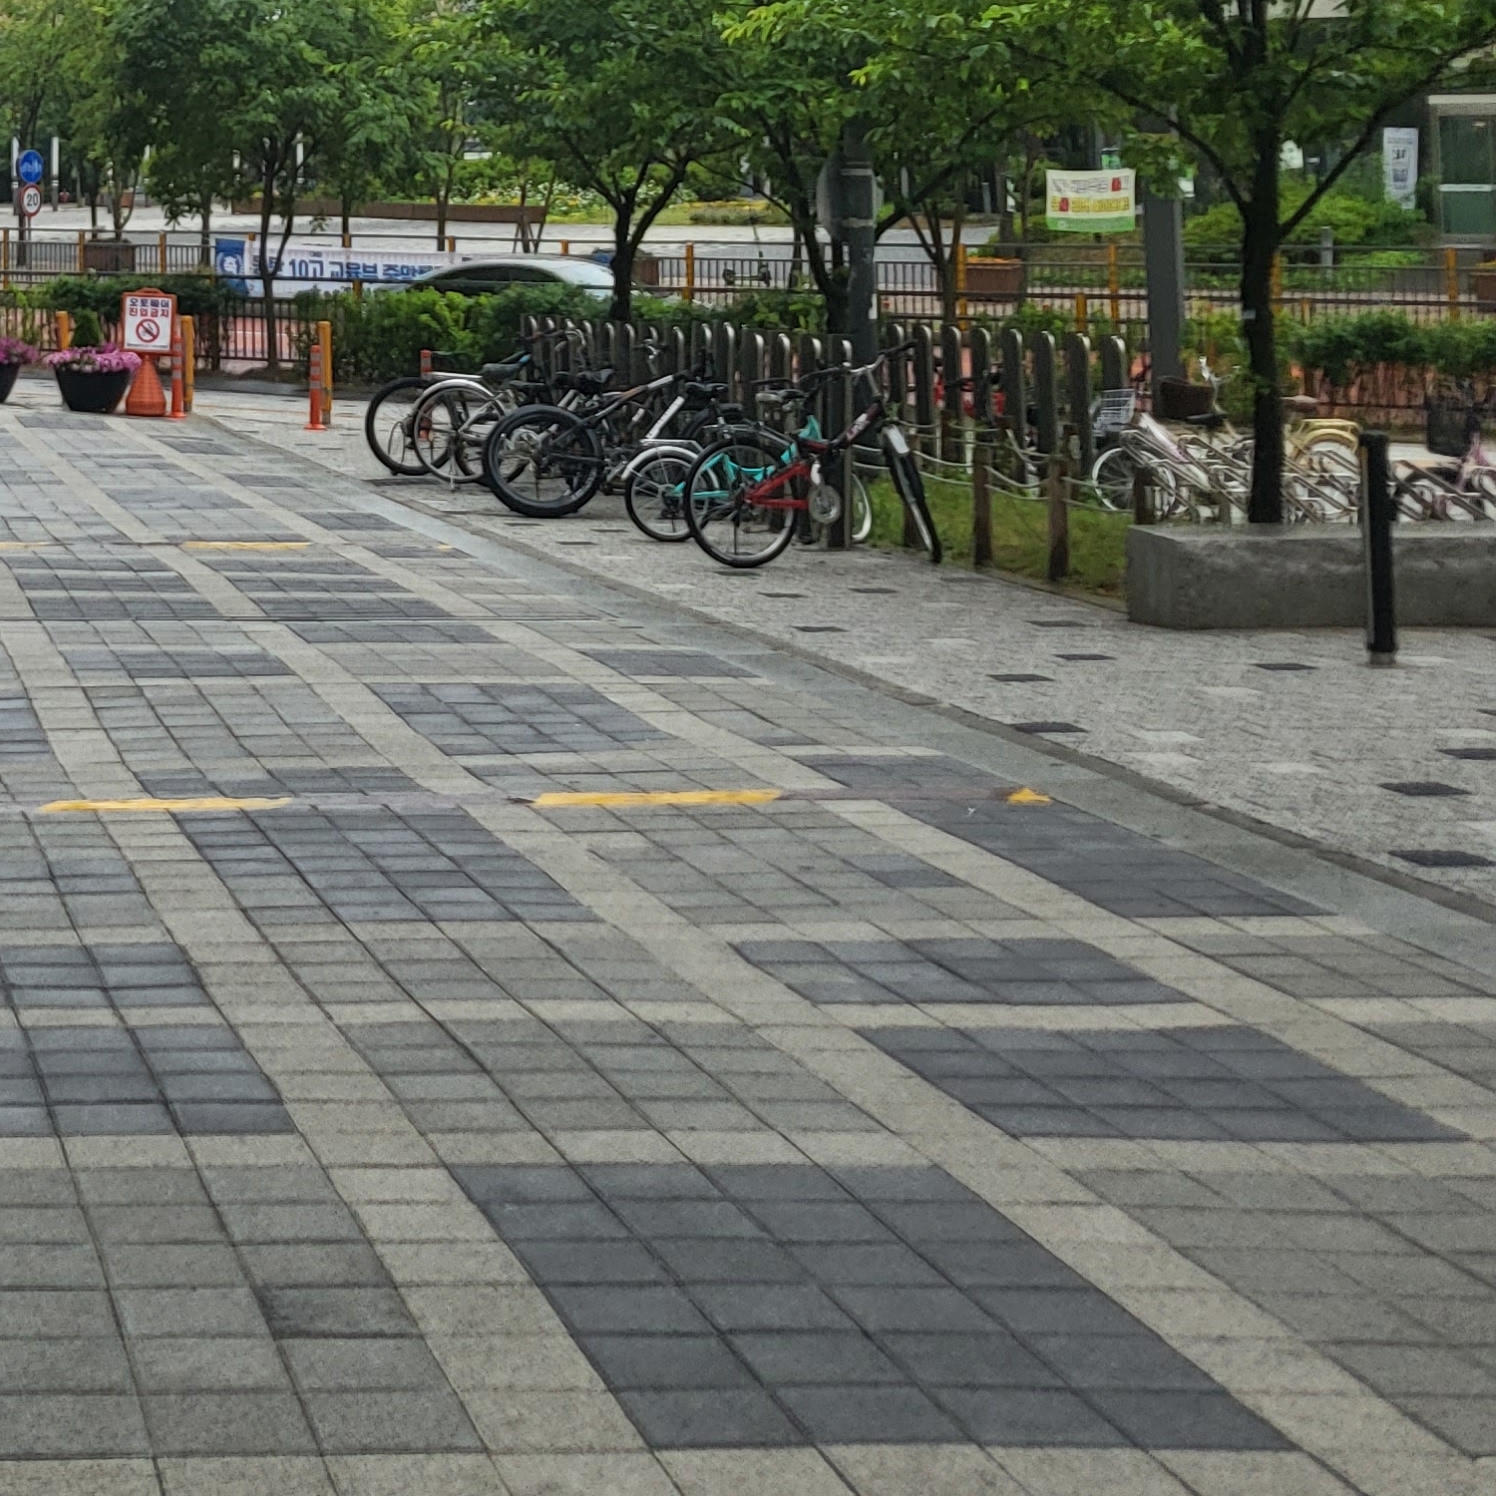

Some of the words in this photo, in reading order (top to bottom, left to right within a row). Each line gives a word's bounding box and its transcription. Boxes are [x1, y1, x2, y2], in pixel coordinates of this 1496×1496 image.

[26, 192, 39, 207] 20
[129, 297, 170, 308] 오토바이
[129, 307, 169, 318] 진입금지
